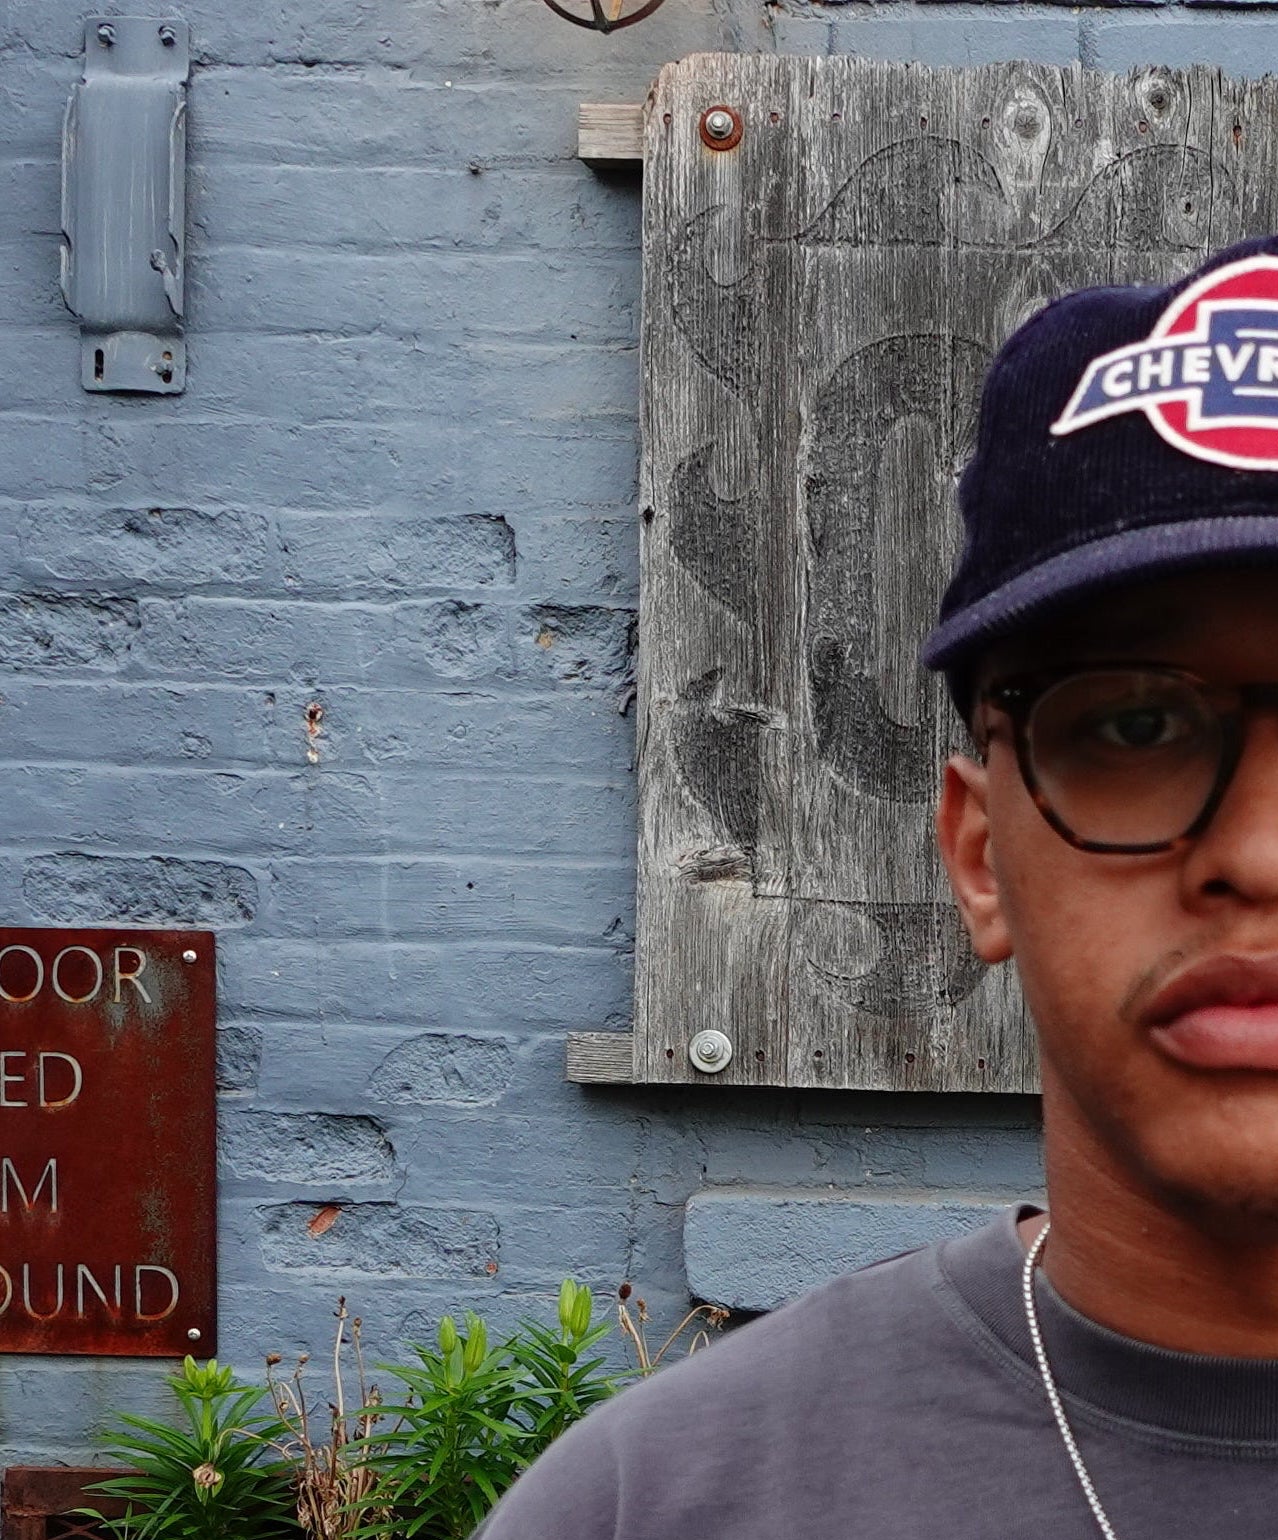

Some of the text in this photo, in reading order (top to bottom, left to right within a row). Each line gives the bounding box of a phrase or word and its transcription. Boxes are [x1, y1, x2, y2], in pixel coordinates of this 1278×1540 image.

[0, 1051, 83, 1108] ED
[2, 1157, 57, 1213] M
[0, 1263, 179, 1320] UND
